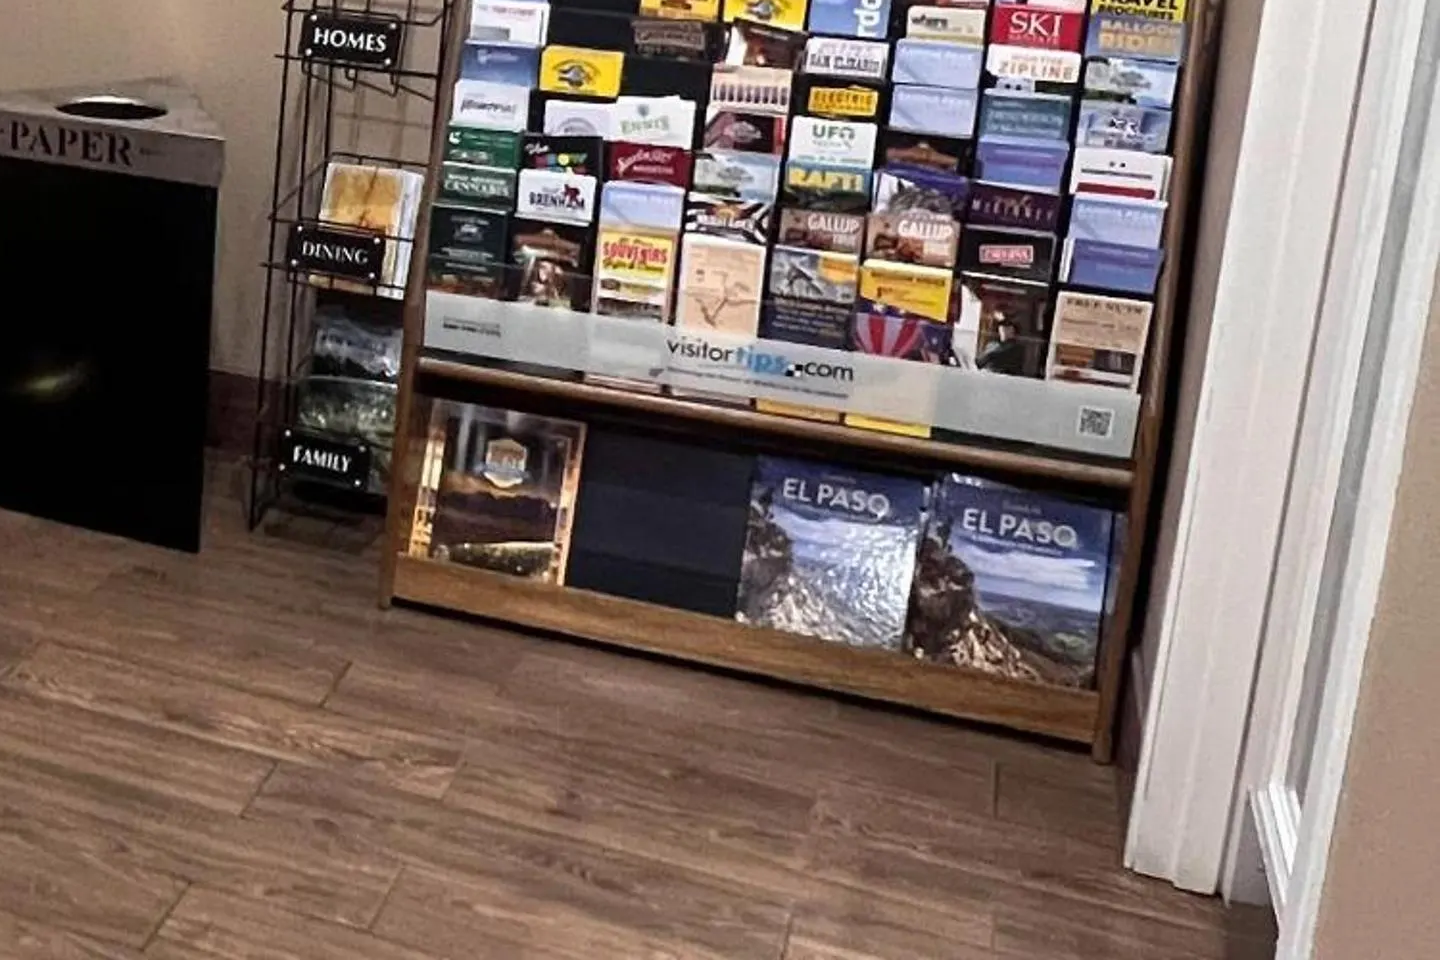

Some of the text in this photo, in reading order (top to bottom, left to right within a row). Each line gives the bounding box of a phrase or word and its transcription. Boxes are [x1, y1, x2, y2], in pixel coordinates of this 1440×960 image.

[1010, 11, 1063, 37] SKI
[313, 27, 387, 52] HOMES
[998, 61, 1073, 80] ZIPLINE
[8, 120, 133, 167] PAPER
[807, 213, 860, 234] GALLUP
[898, 219, 954, 239] GALLUP
[301, 241, 369, 265] DINING
[292, 445, 352, 473] FAMILY
[781, 477, 891, 518] EL PASO
[963, 507, 993, 535] EL
[999, 513, 1078, 548] PASO
